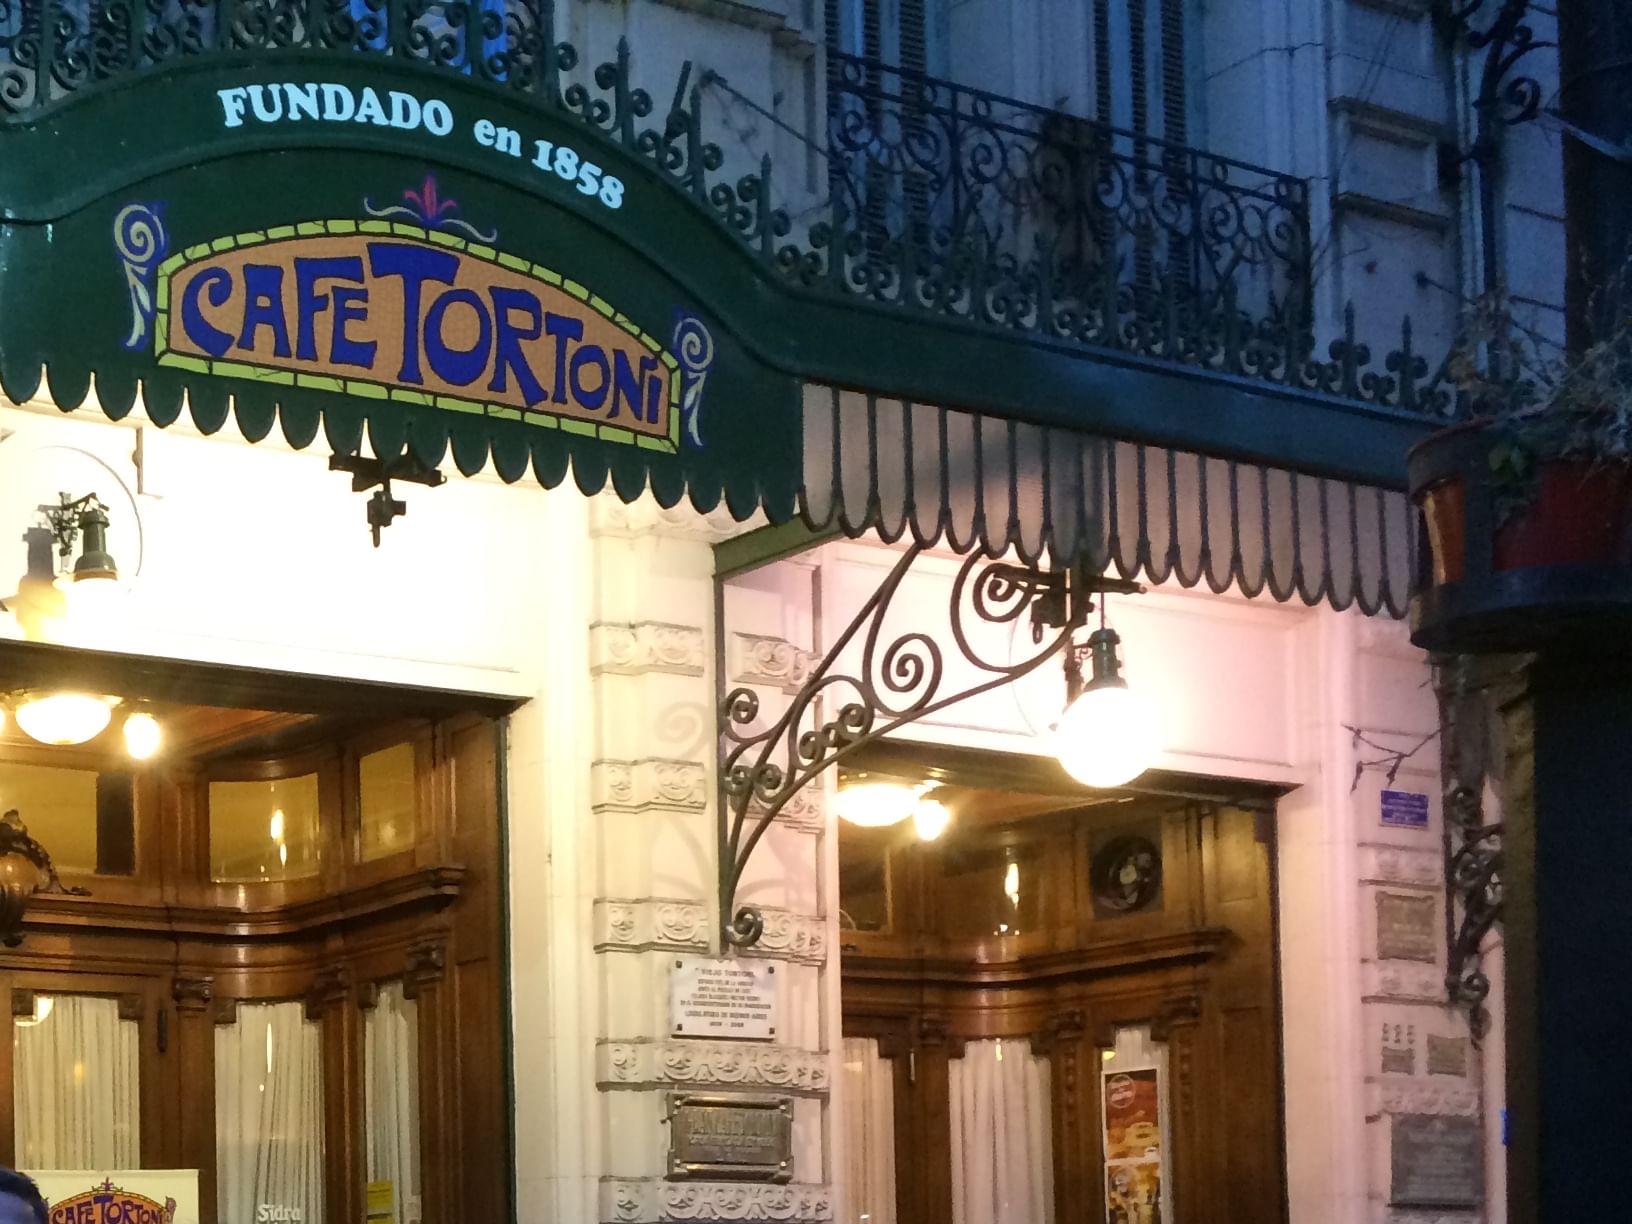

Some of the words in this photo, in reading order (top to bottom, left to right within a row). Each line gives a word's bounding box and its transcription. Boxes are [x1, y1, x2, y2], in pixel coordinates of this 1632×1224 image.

[217, 83, 454, 136] FUNDADO
[473, 118, 522, 157] en
[531, 139, 625, 209] 1858
[181, 255, 377, 369] CAFE
[367, 242, 663, 425] TORTONI
[258, 1204, 301, 1221] Sidra
